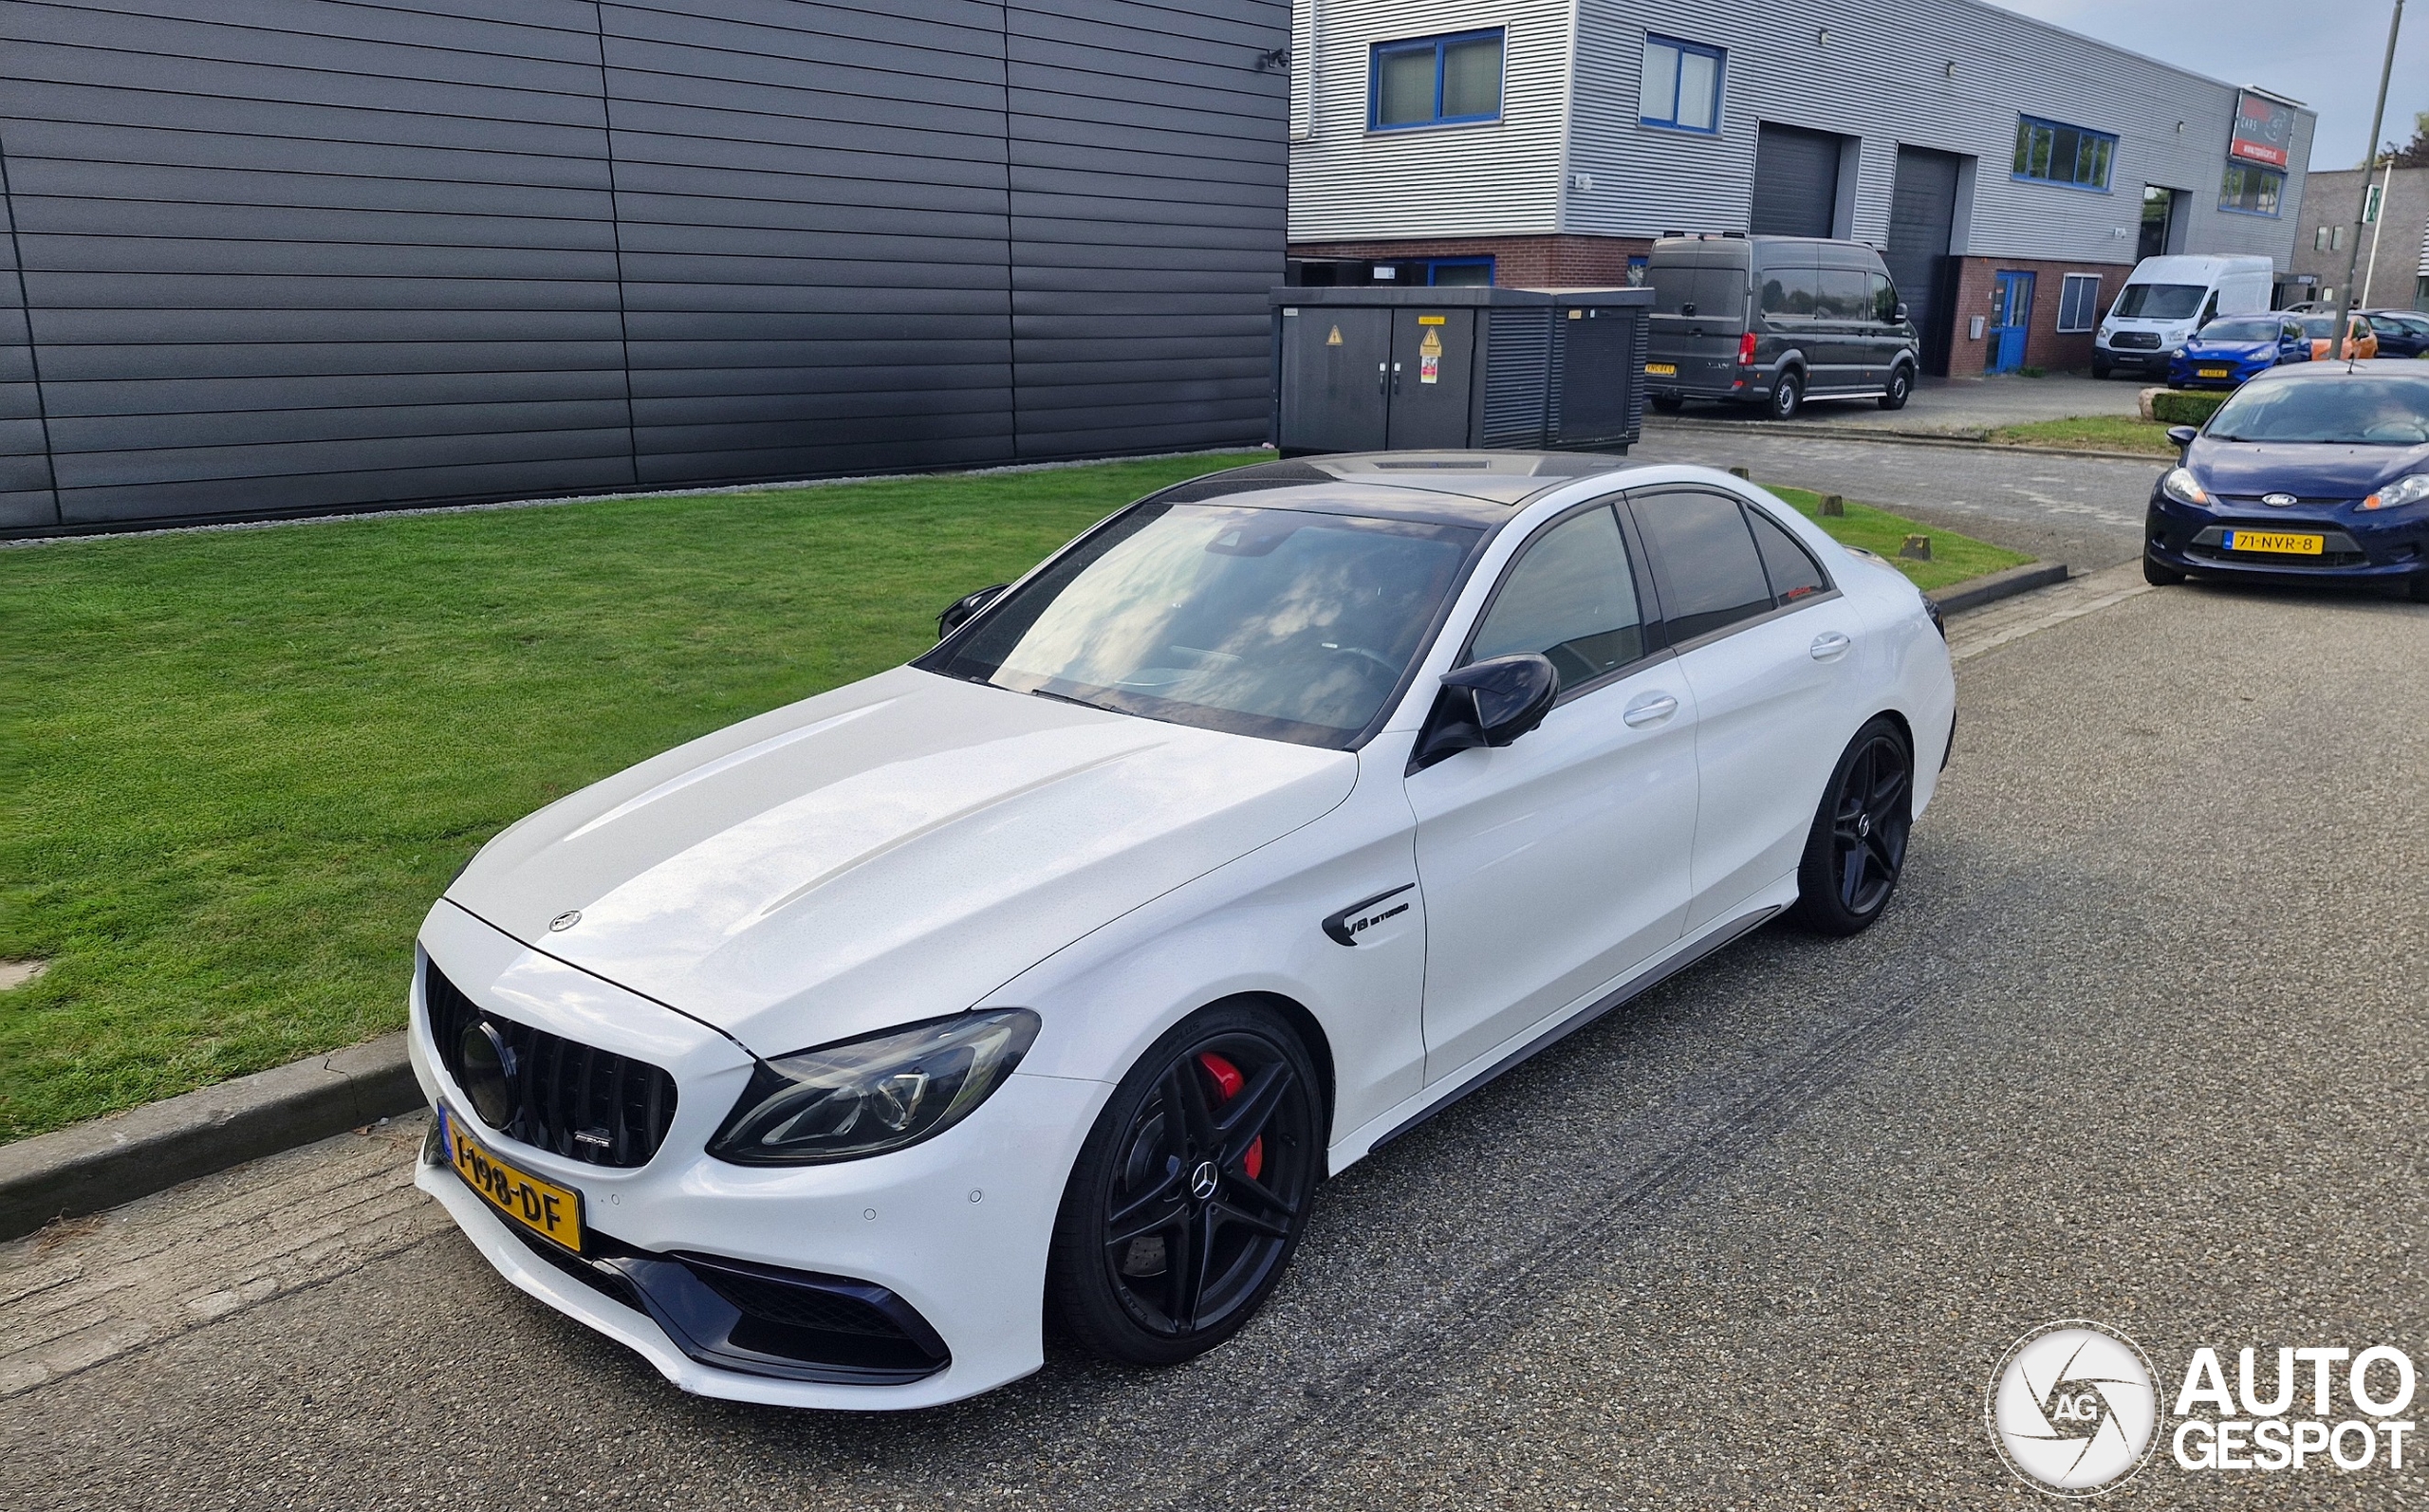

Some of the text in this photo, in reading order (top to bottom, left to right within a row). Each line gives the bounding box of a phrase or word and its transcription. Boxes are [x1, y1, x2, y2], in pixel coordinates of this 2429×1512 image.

[2239, 534, 2312, 550] 71-NVR-8
[1344, 917, 1368, 936] V8
[453, 1129, 561, 1231] T-198-DF
